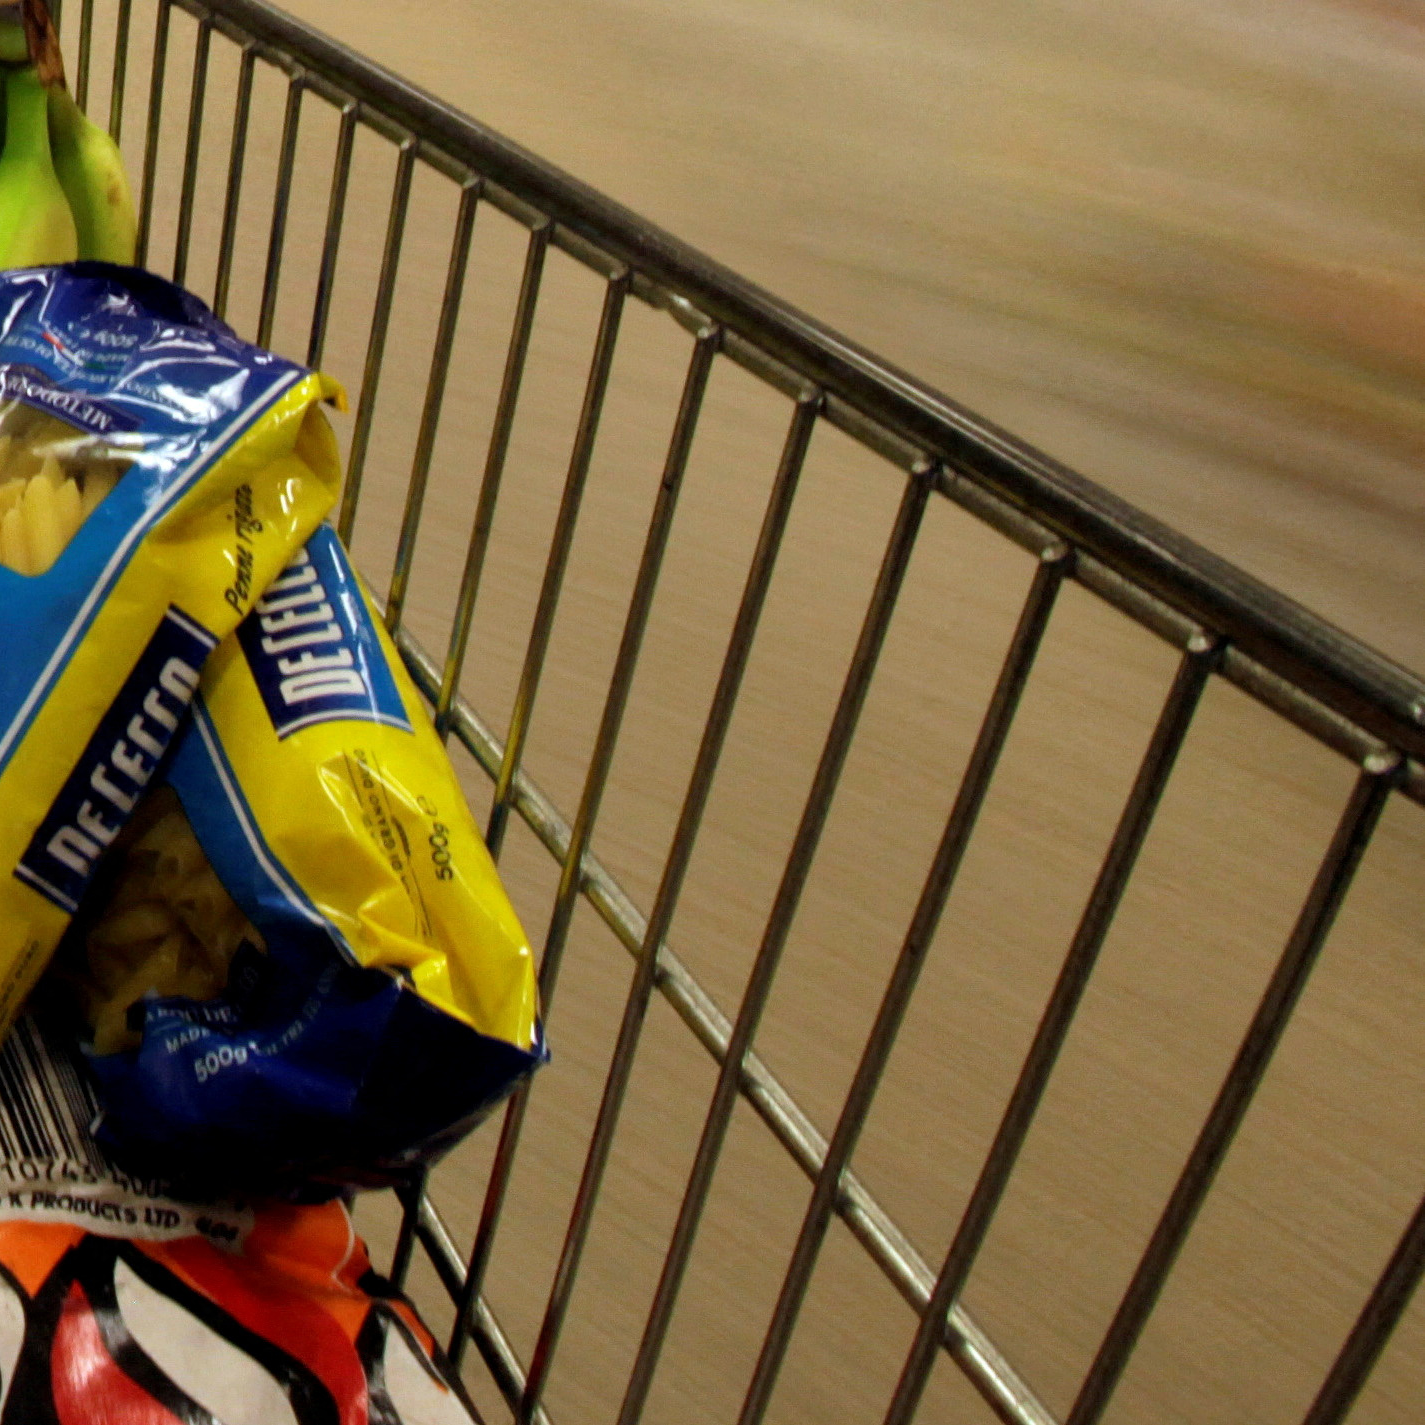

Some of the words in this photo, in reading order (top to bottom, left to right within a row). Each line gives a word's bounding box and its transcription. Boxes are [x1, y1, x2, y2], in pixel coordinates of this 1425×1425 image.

[224, 543, 254, 616] Penne
[255, 547, 343, 654] CECC
[193, 1043, 249, 1084] 500g
[7, 1191, 24, 1208] K
[30, 1191, 138, 1226] PRODUCTS
[143, 1206, 181, 1229] LTD
